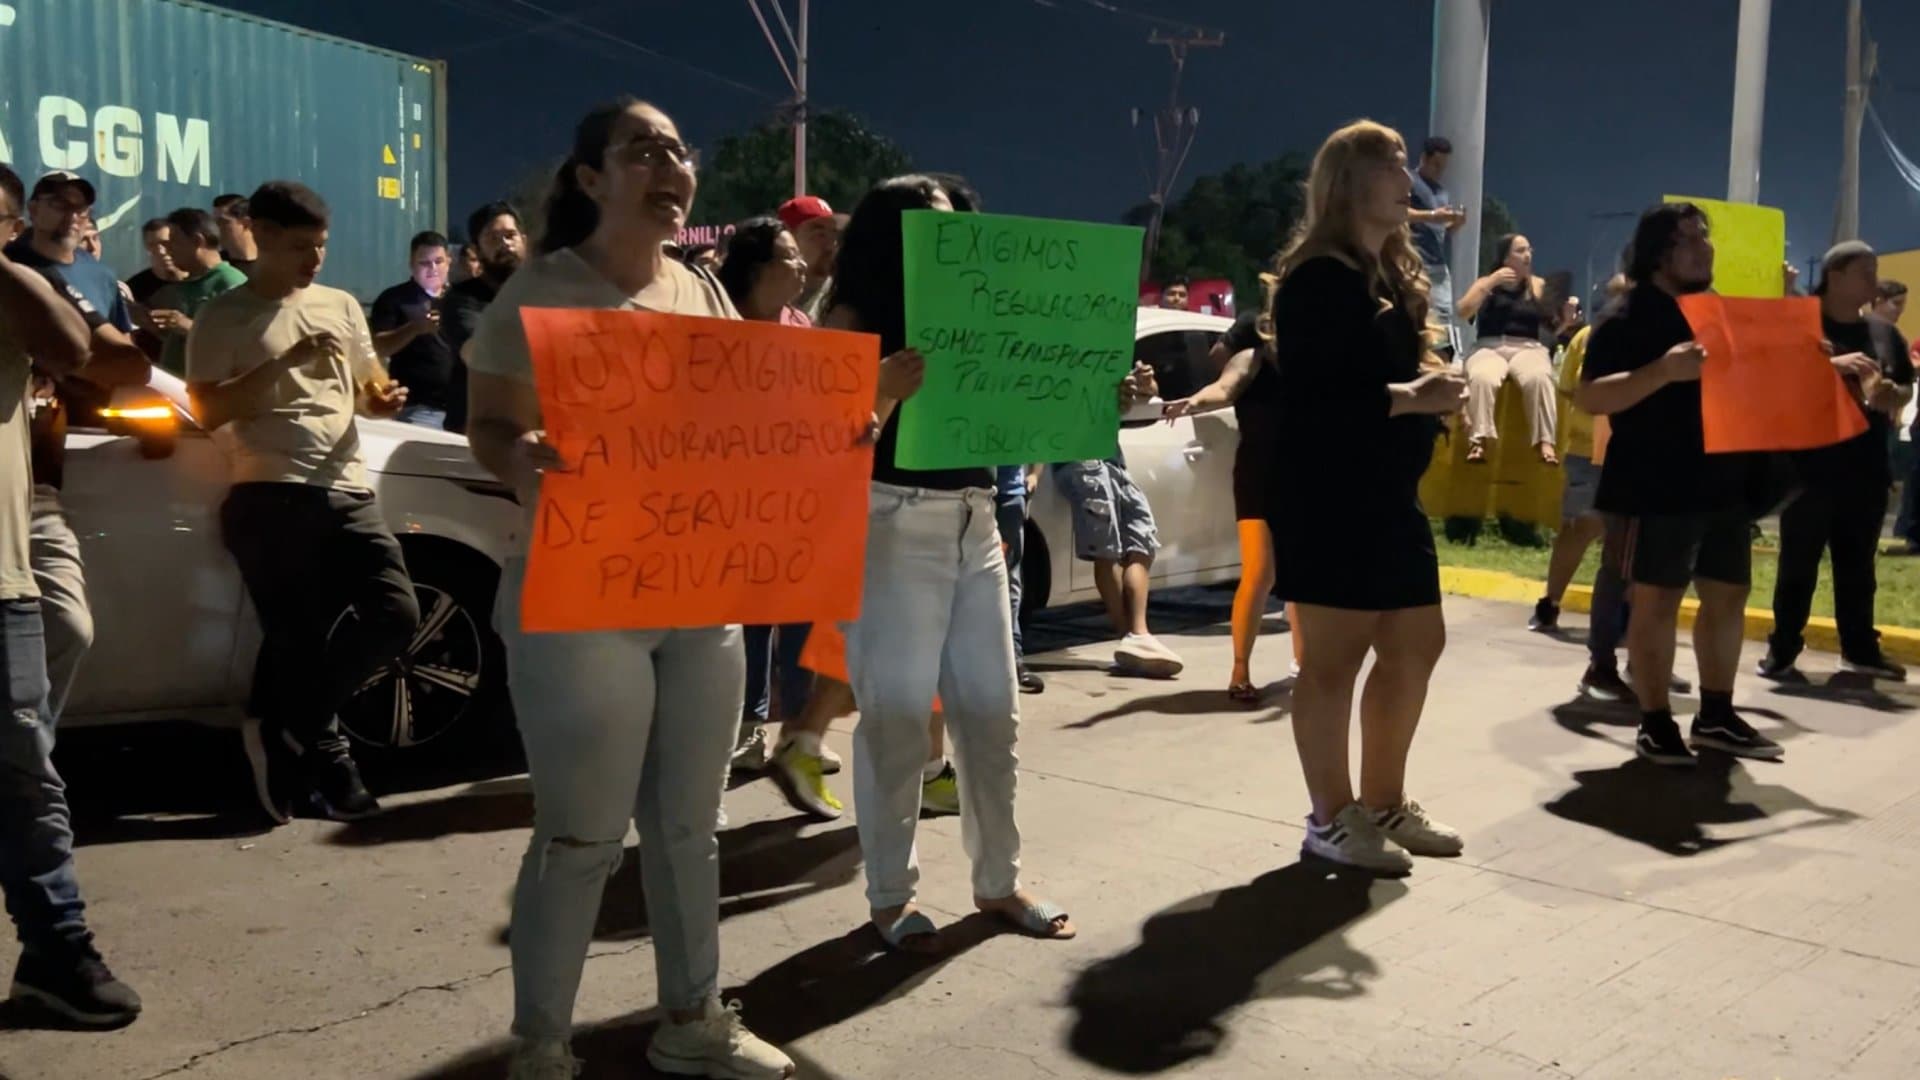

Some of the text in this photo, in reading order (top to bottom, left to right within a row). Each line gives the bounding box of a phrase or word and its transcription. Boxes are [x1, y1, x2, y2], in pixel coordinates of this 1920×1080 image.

[39, 95, 211, 187] CGM
[936, 220, 1079, 271] EXIGIMOS
[688, 332, 863, 394] EXIGIMOS
[541, 488, 822, 549] DE SERVICIO
[599, 537, 814, 599] PRIVADO
